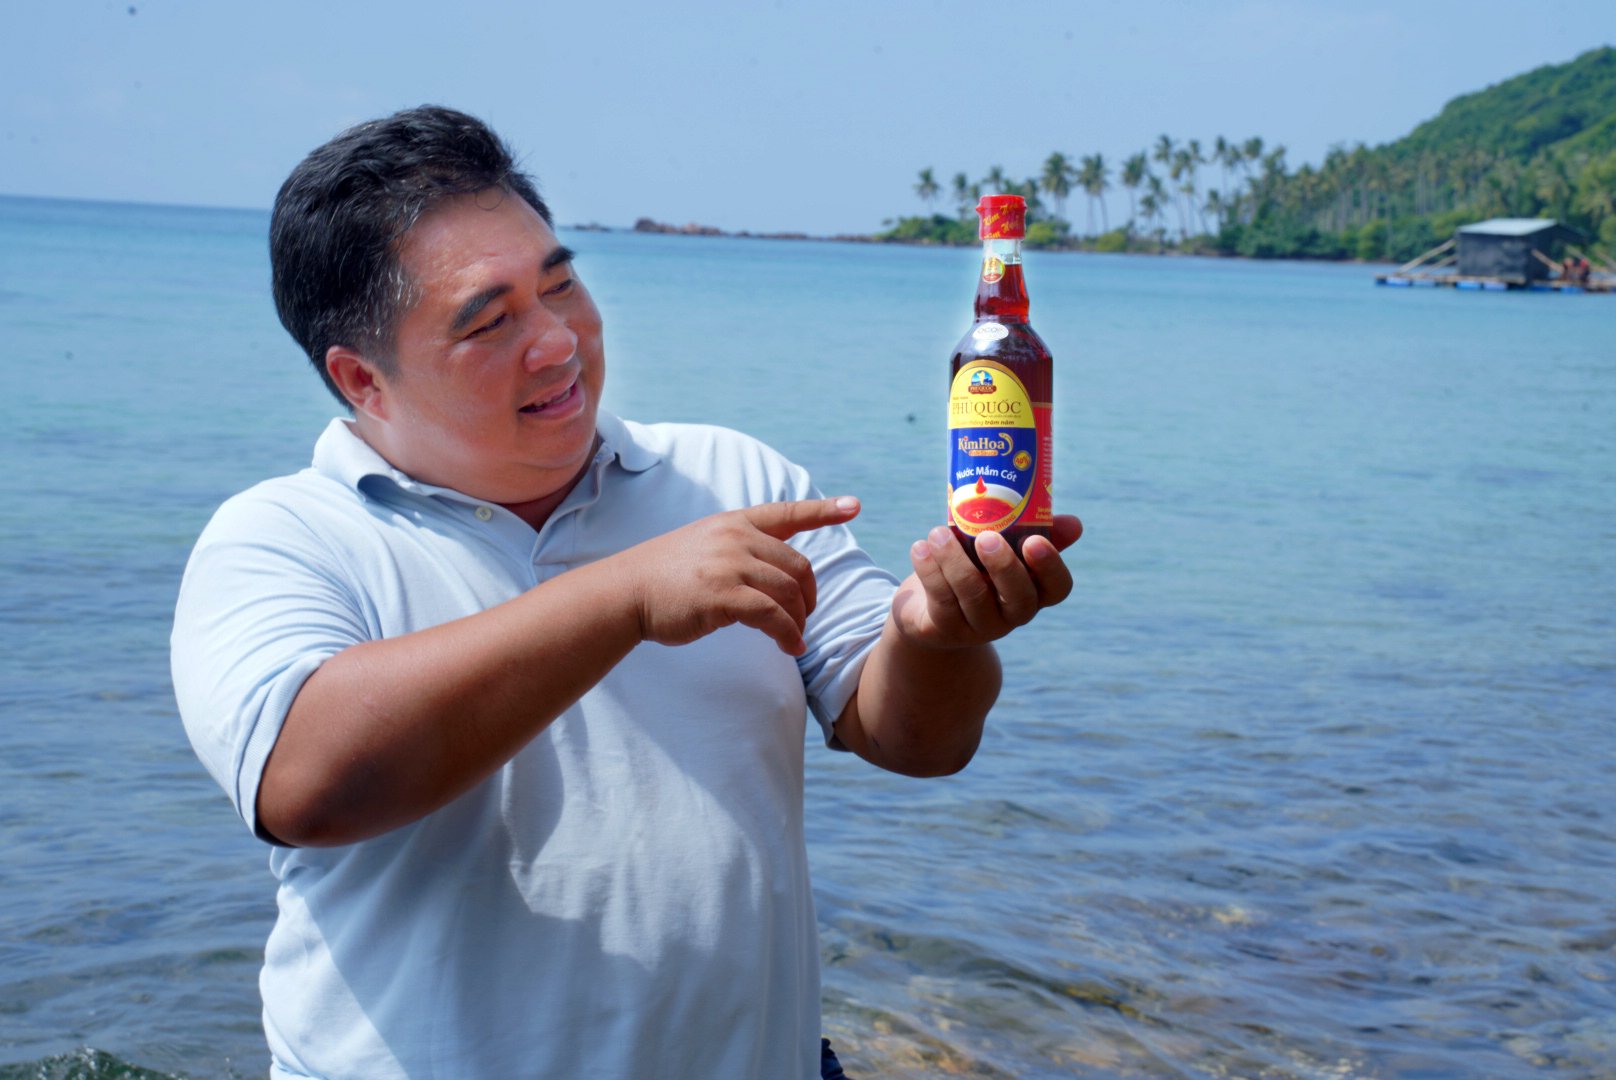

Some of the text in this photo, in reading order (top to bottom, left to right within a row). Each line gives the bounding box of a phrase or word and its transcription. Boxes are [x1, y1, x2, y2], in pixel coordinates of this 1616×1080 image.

[956, 465, 1018, 483] Nước Mắm Cốt
